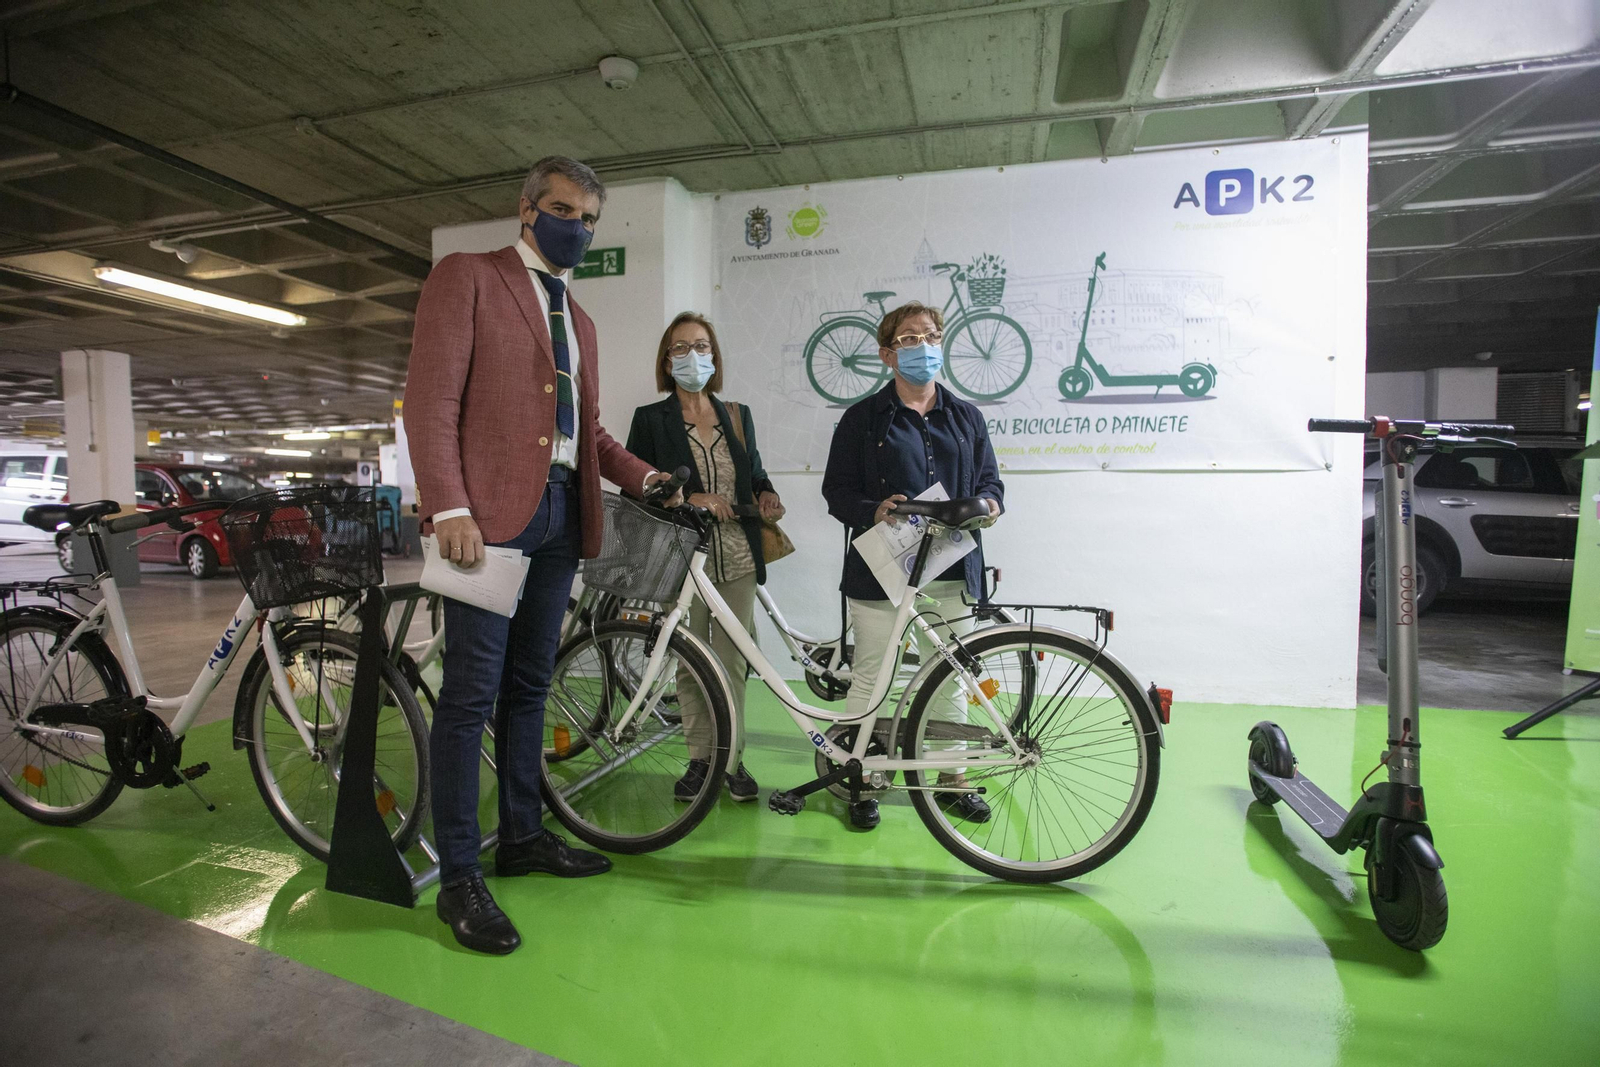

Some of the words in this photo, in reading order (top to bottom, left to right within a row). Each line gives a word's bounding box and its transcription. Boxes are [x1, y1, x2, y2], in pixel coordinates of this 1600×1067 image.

[1173, 170, 1315, 213] APK2
[730, 252, 789, 263] AYUNTAMIENTO
[801, 248, 840, 257] GRANADA
[987, 418, 1007, 436] EN
[1012, 416, 1091, 436] BICICLETA
[1095, 417, 1108, 433] O
[1112, 415, 1189, 434] PATINETE
[1029, 446, 1042, 455] en
[1044, 442, 1058, 455] el
[1059, 443, 1094, 455] centro
[1096, 442, 1110, 454] de
[1113, 441, 1157, 454] control
[1401, 490, 1411, 526] APK2
[1396, 565, 1415, 626] bongo
[938, 644, 964, 674] ORBEA
[807, 730, 833, 756] APK2
